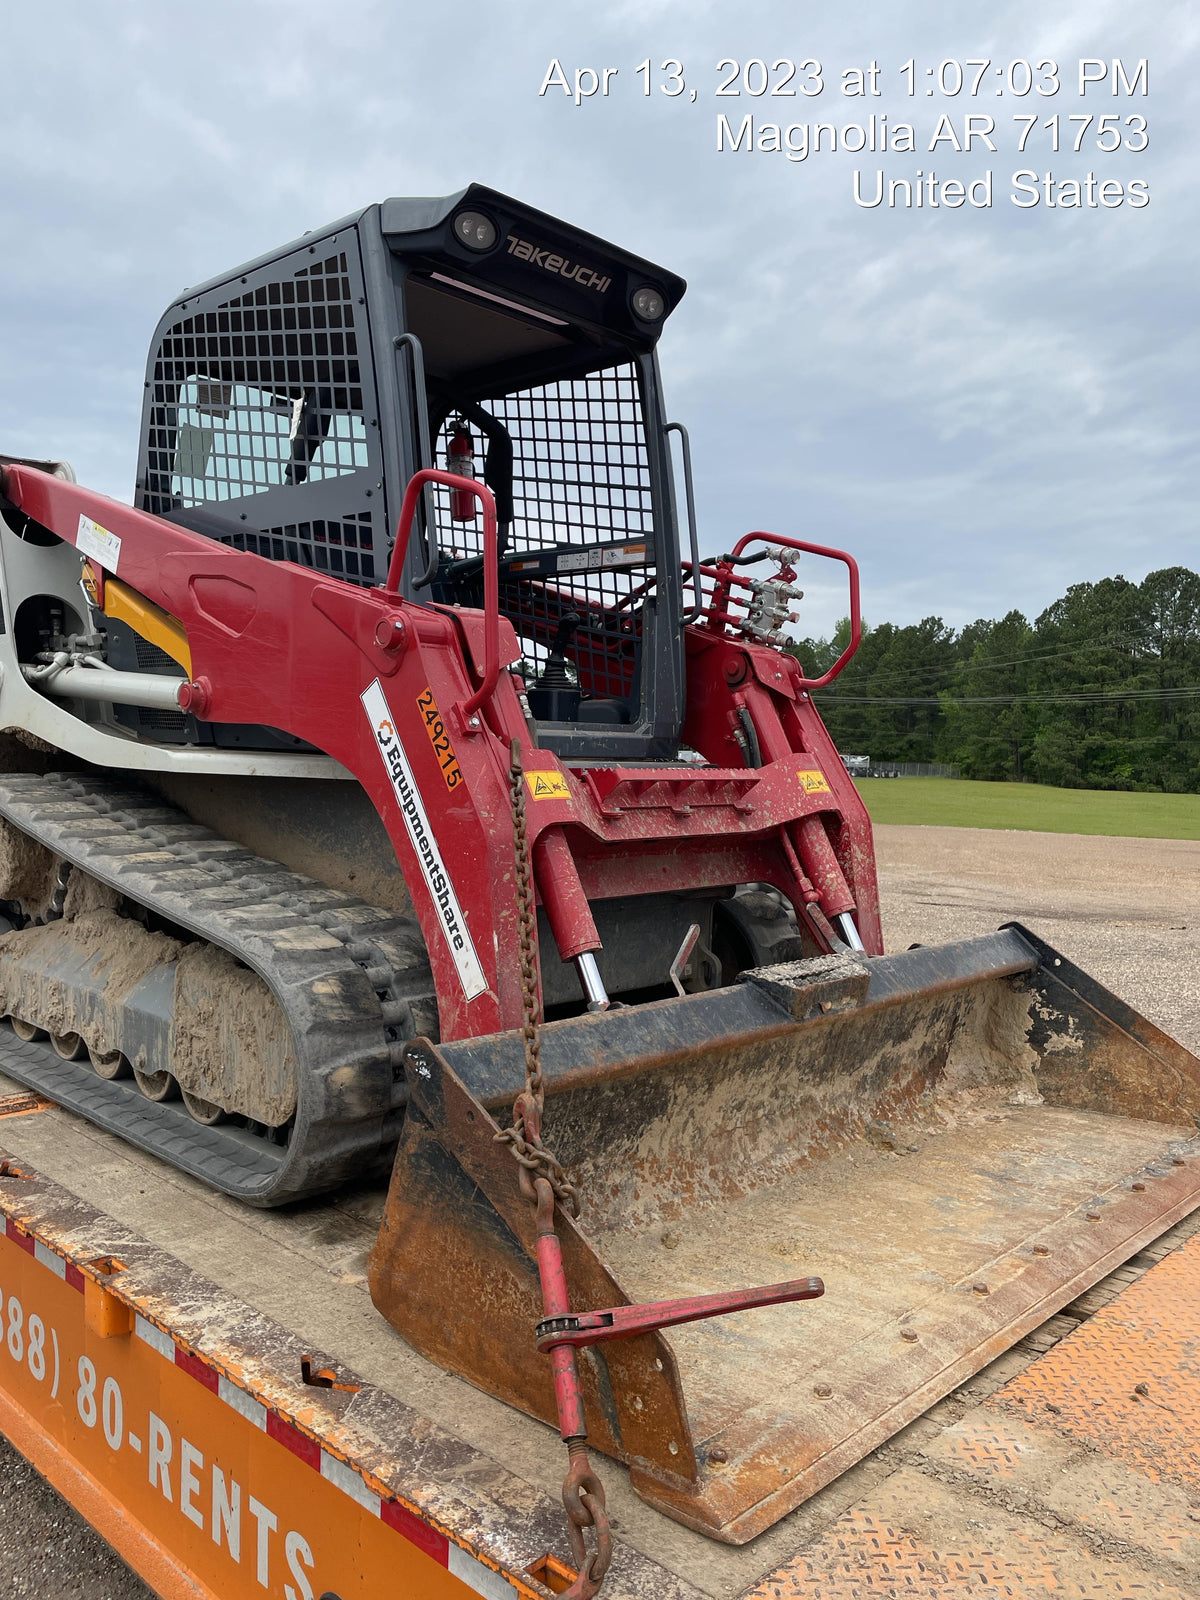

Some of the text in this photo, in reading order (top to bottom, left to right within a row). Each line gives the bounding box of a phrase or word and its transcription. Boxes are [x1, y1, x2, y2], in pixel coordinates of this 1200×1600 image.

[506, 235, 612, 293] TAKEUCHI
[417, 690, 463, 789] 249215
[387, 744, 464, 951] EquipmentShare
[0, 1287, 315, 1600] 88) 80-RENTS
